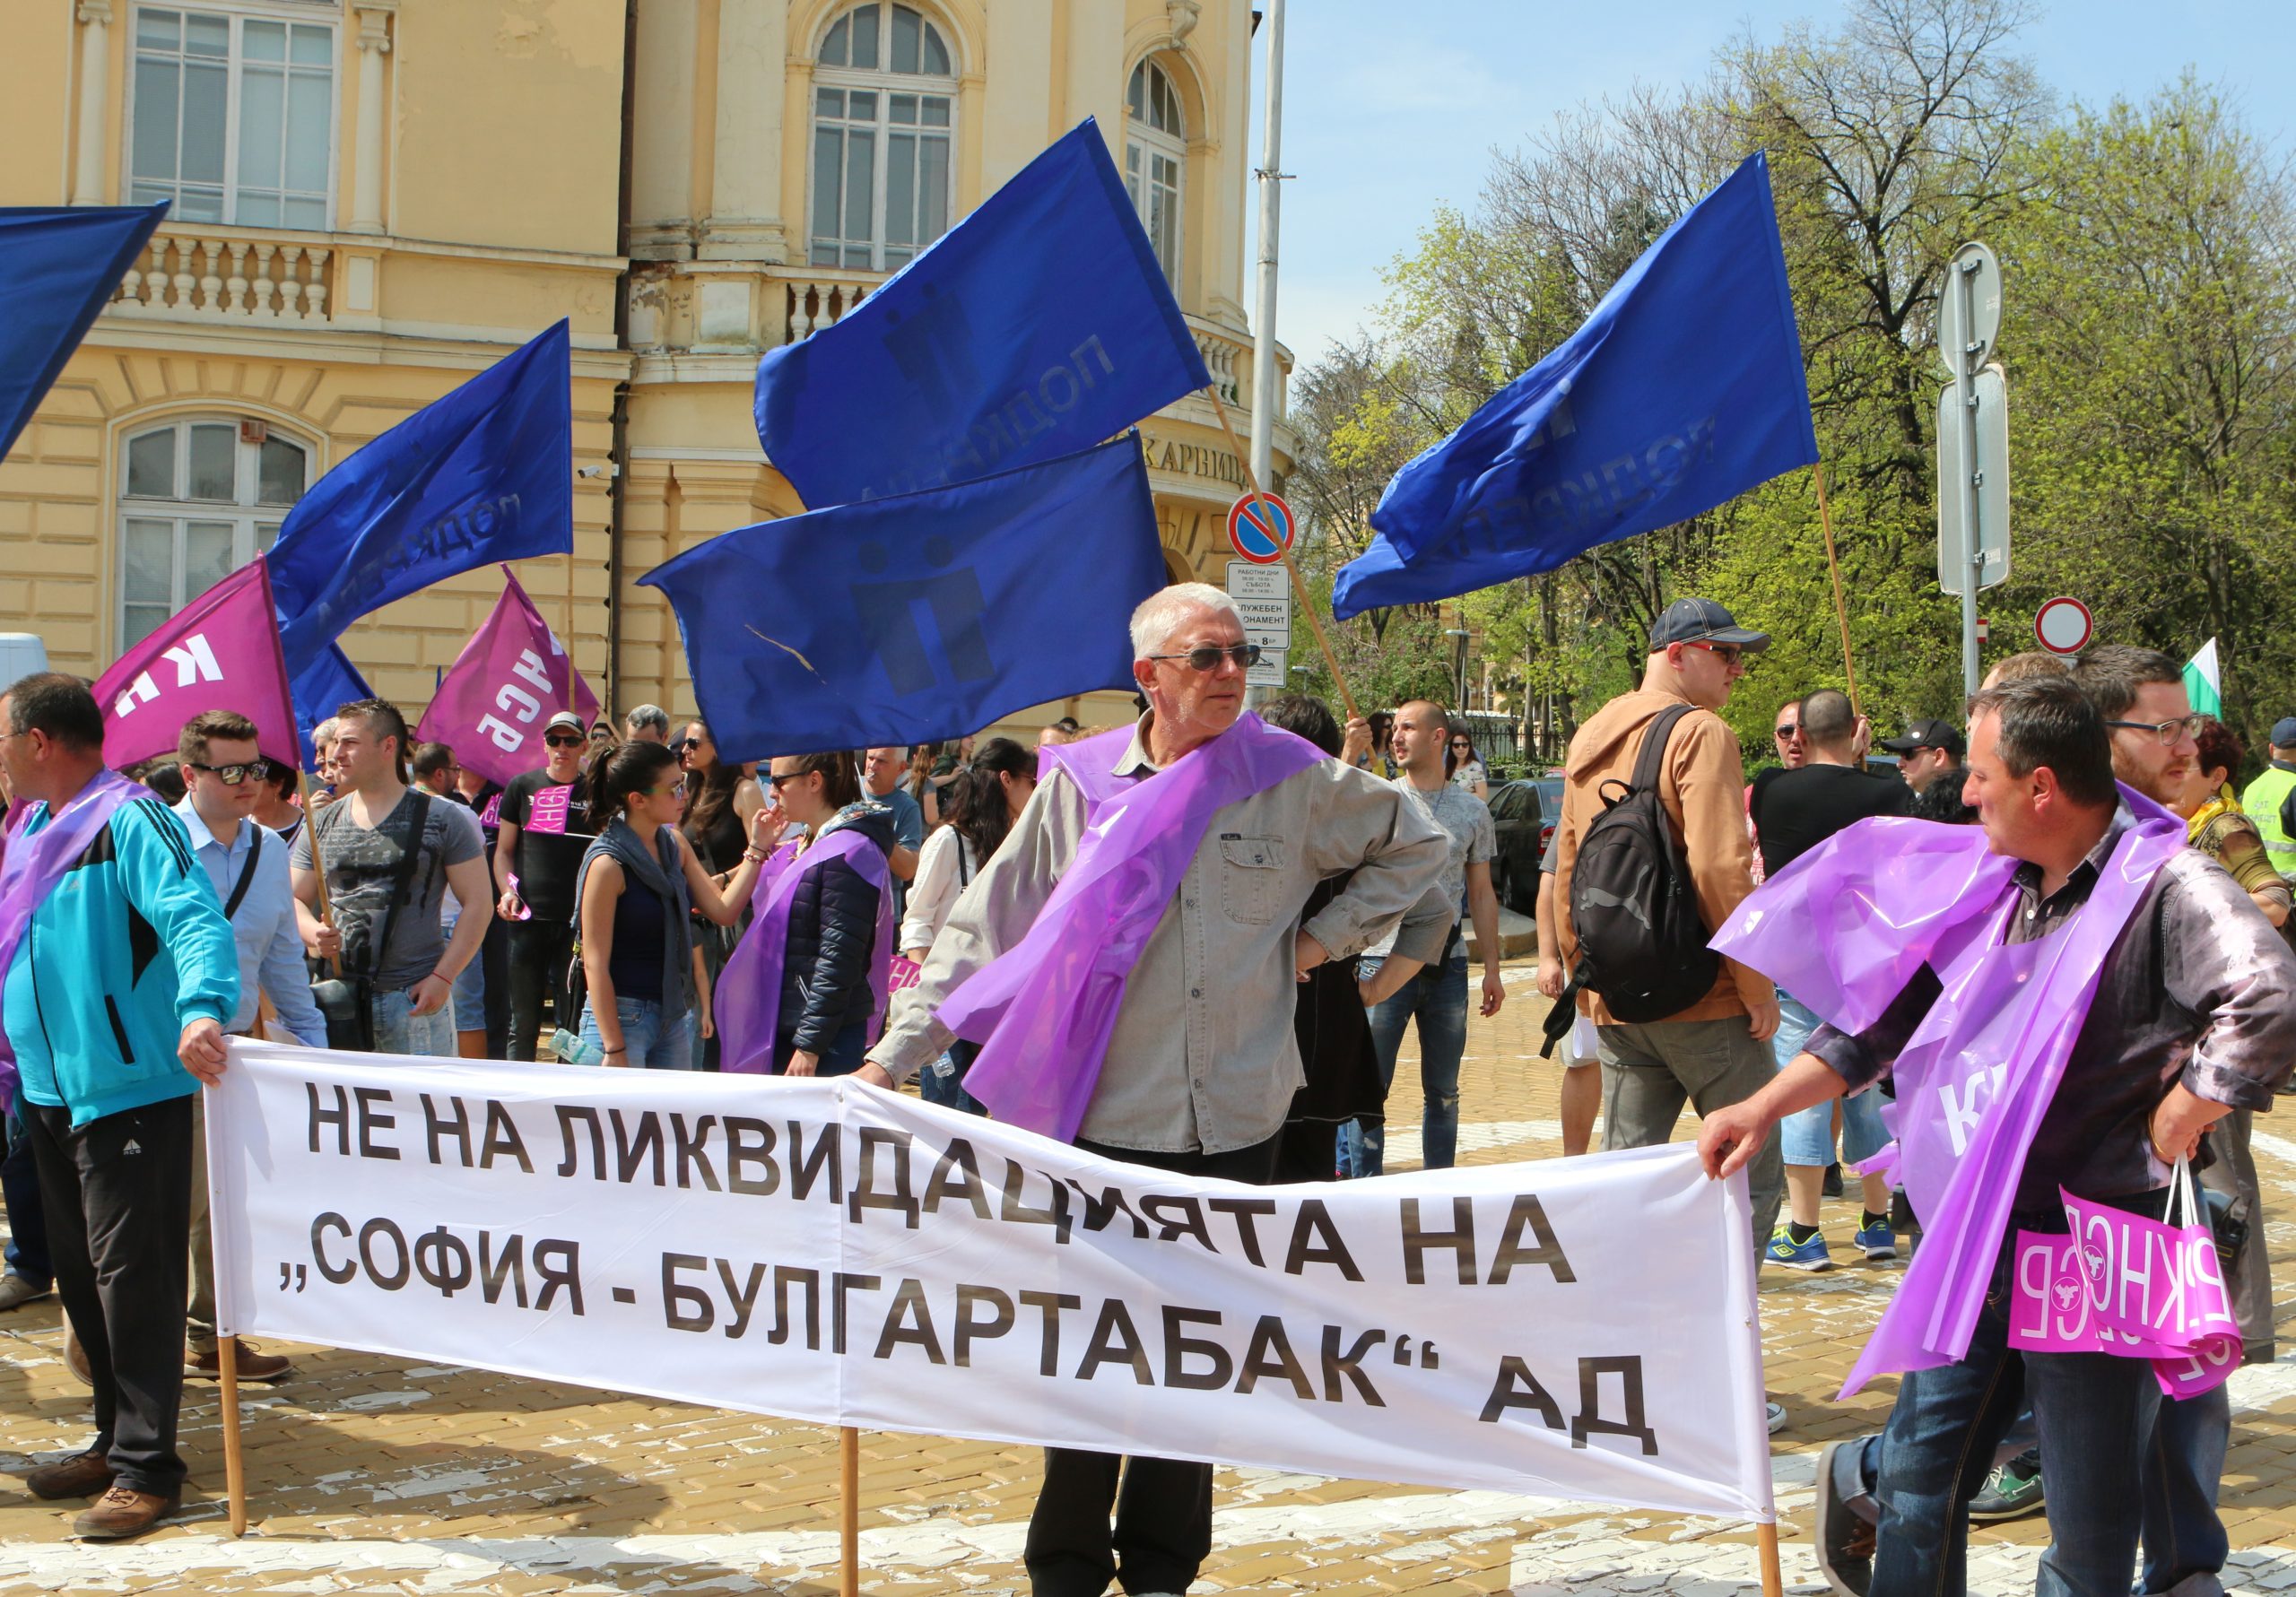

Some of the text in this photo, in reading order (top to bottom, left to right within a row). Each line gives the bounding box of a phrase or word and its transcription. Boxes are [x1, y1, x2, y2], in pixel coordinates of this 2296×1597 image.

[1262, 637, 1268, 646] 8
[306, 1081, 1577, 1285] НЕ НА ЛИКВИДАЦИЯТА НА
[280, 1211, 585, 1316] „СОФИЯ
[662, 1252, 1439, 1407] БУЛГАРТАБАК“
[1478, 1355, 1658, 1455] АД
